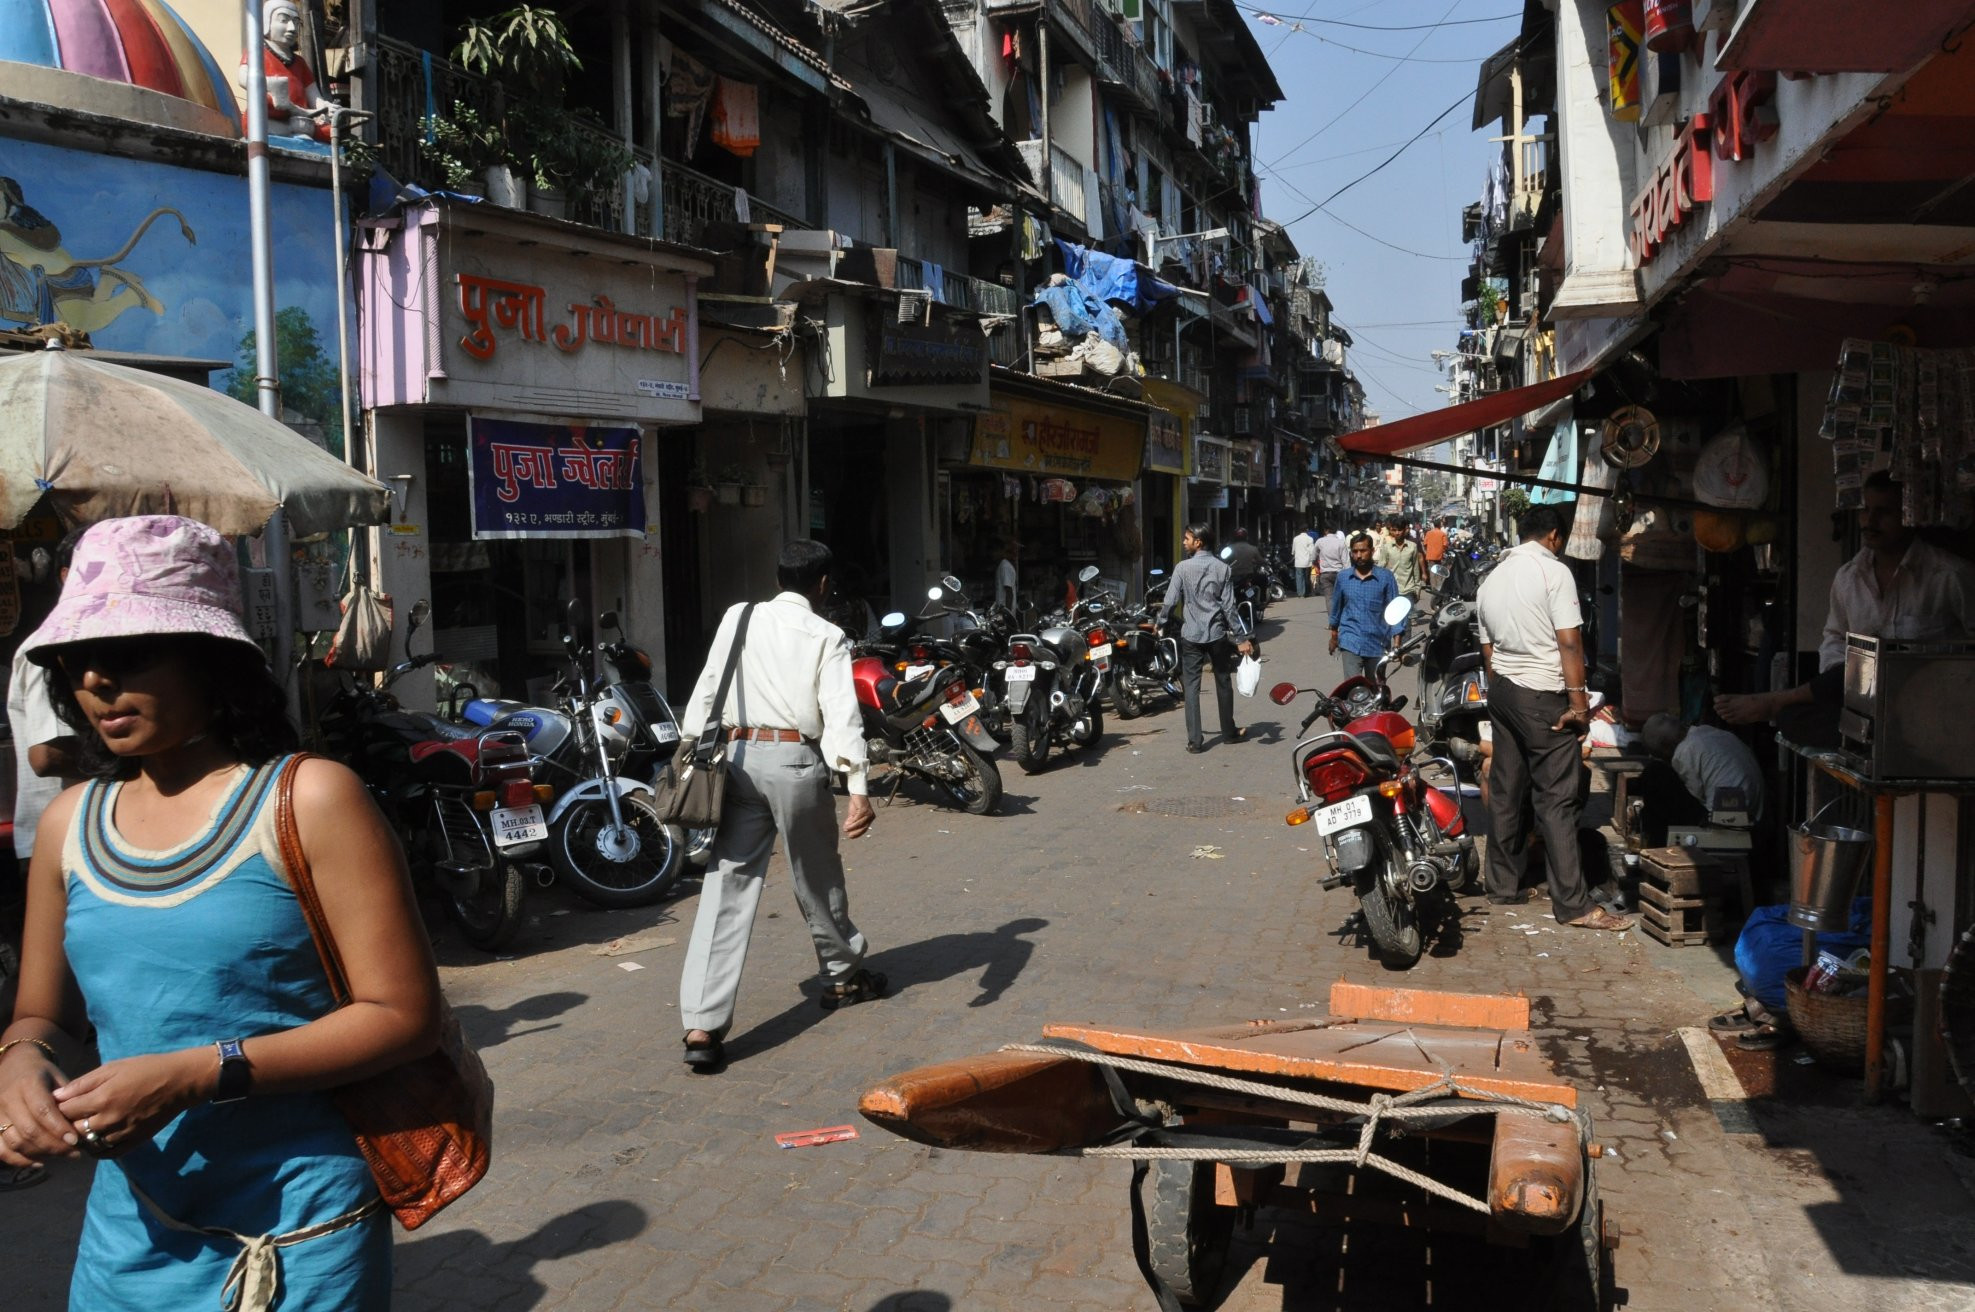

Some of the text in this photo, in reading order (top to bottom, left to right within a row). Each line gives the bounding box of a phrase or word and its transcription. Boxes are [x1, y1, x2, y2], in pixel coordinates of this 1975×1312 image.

[456, 272, 547, 360] पुजा
[490, 442, 557, 503] पुजा
[505, 512, 528, 524] १३२
[544, 510, 573, 524] भण्डारी
[1330, 801, 1355, 816] MH 01
[1327, 808, 1362, 827] AD 3779
[506, 828, 537, 841] 4442
